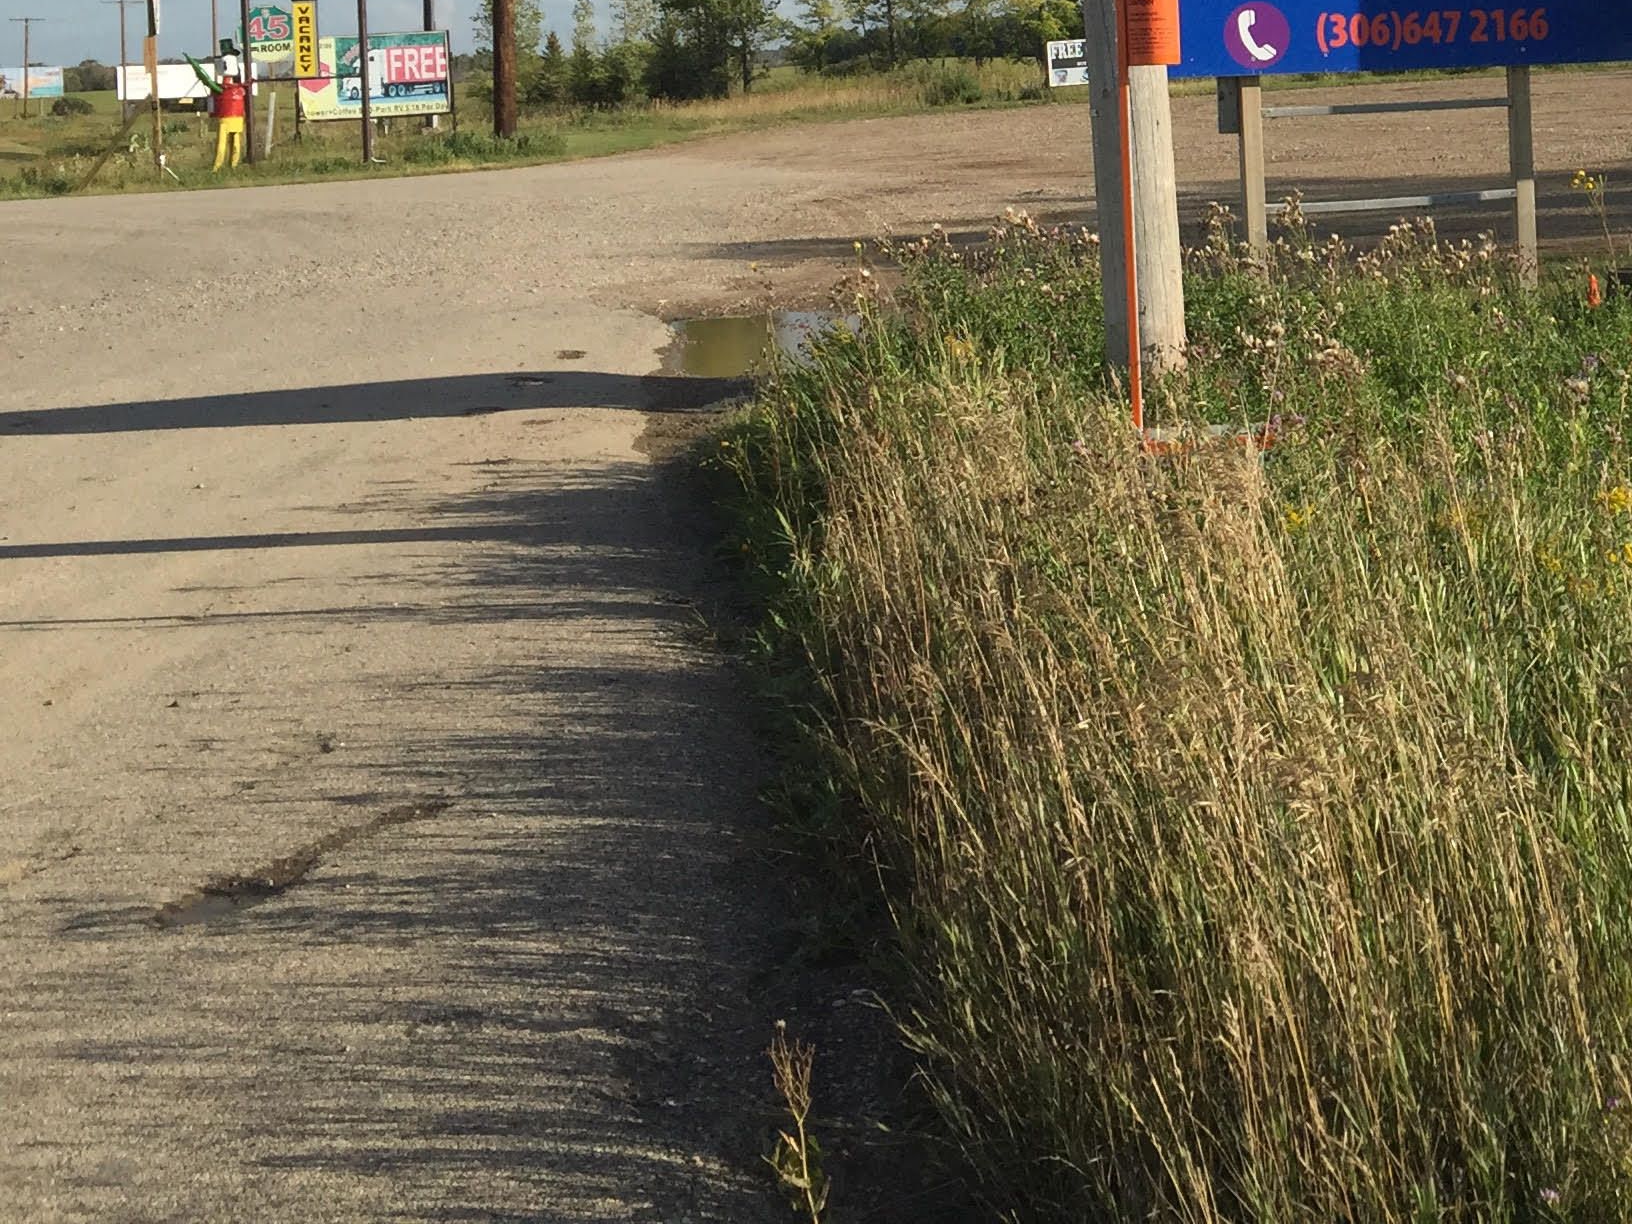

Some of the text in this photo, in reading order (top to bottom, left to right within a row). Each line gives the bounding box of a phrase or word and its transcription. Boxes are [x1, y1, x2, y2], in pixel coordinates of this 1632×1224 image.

[298, 6, 314, 73] VACANCY
[1469, 7, 1549, 43] 2166
[260, 42, 291, 53] ROOM
[389, 46, 448, 81] FREE
[1051, 42, 1084, 60] FREE
